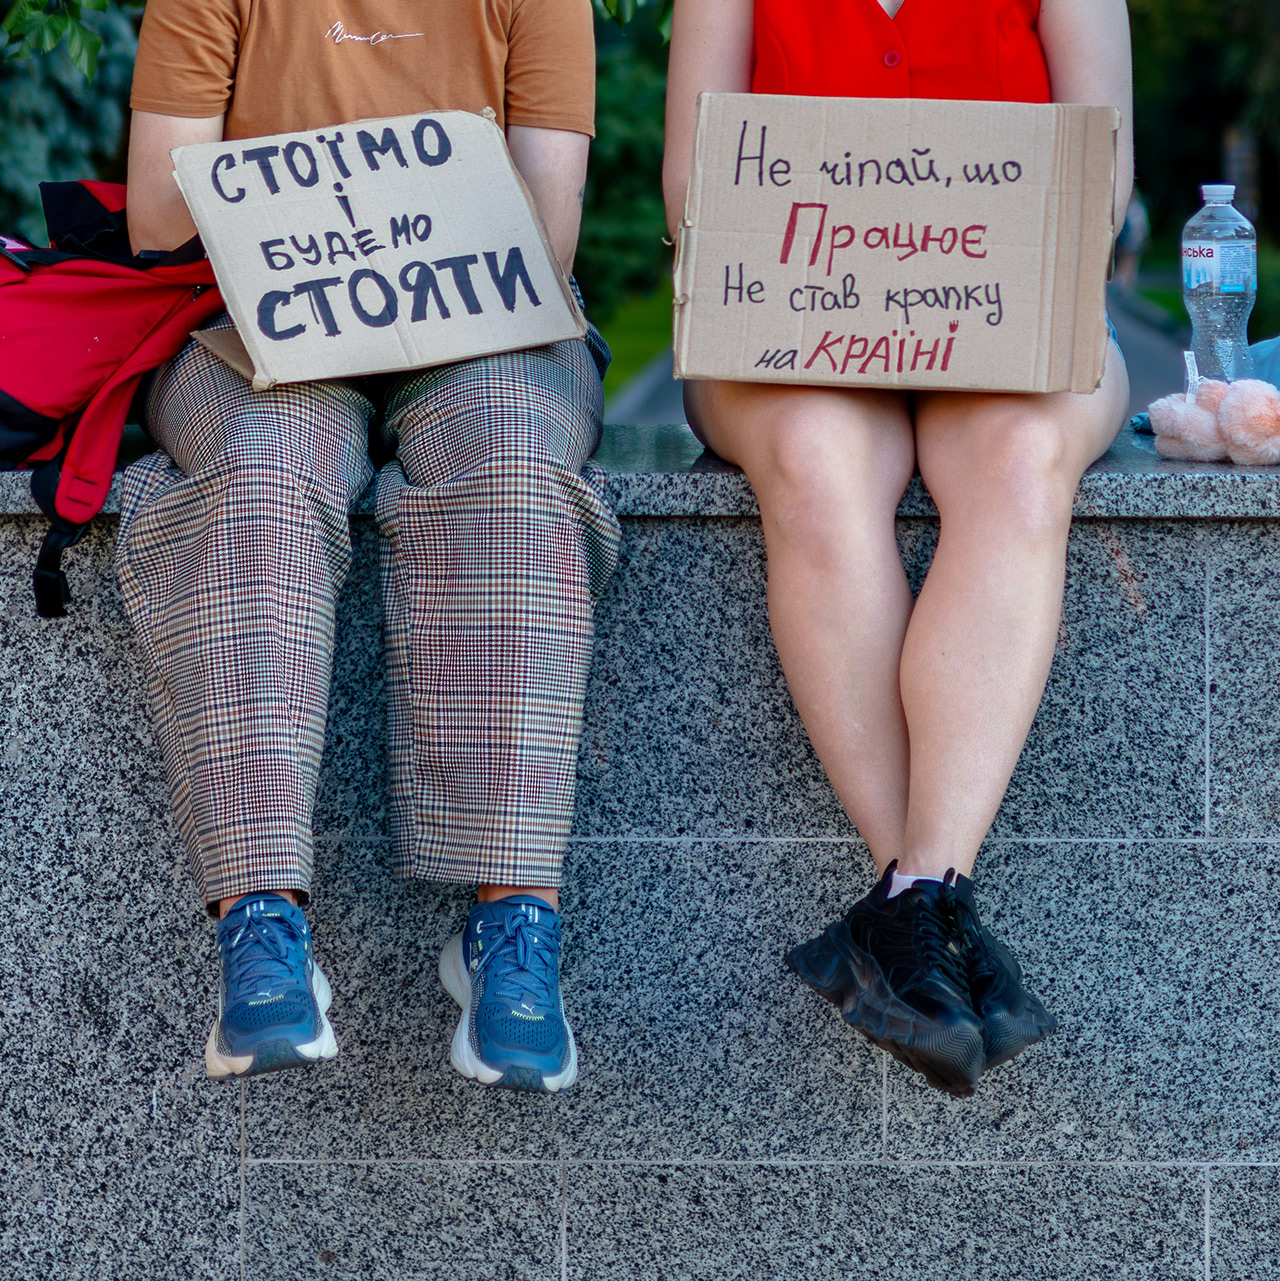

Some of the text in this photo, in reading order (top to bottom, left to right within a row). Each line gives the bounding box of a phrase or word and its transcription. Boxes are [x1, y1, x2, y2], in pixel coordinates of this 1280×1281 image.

[211, 118, 453, 204] СТОЇМО
[734, 120, 1023, 188] Не чіпай, що
[332, 182, 358, 228] і
[259, 213, 433, 271] БУДЕМО
[779, 202, 989, 276] Працює
[256, 247, 542, 341] СТОЯТИ
[723, 263, 1003, 326] Не став крапку
[754, 320, 959, 375] на КРАЇНІ
